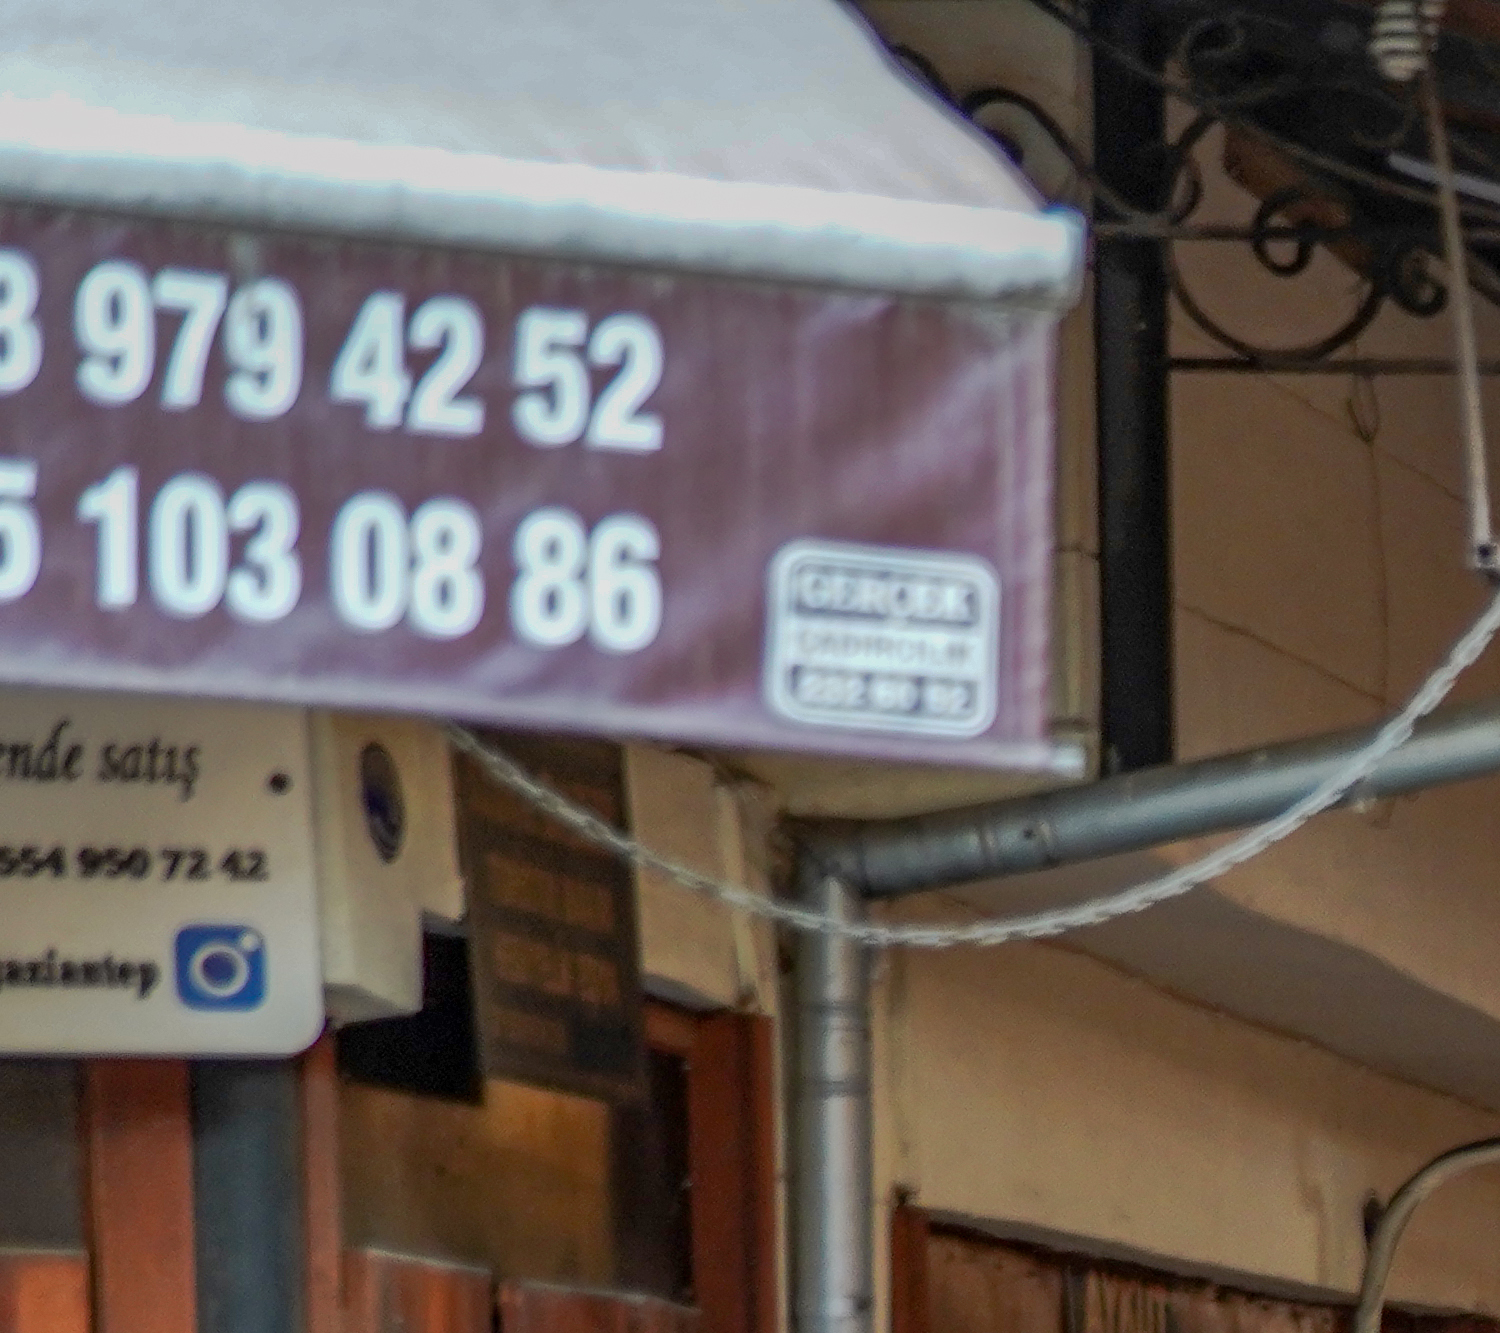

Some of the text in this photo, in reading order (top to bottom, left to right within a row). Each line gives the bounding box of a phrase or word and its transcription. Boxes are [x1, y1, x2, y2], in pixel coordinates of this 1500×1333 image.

[75, 259, 303, 419] 979
[331, 291, 487, 438] 42
[513, 305, 665, 453] 52
[78, 464, 303, 623] 103
[332, 490, 487, 639] 08
[511, 504, 662, 654] 86
[161, 847, 212, 880] 72
[219, 848, 269, 881] 42
